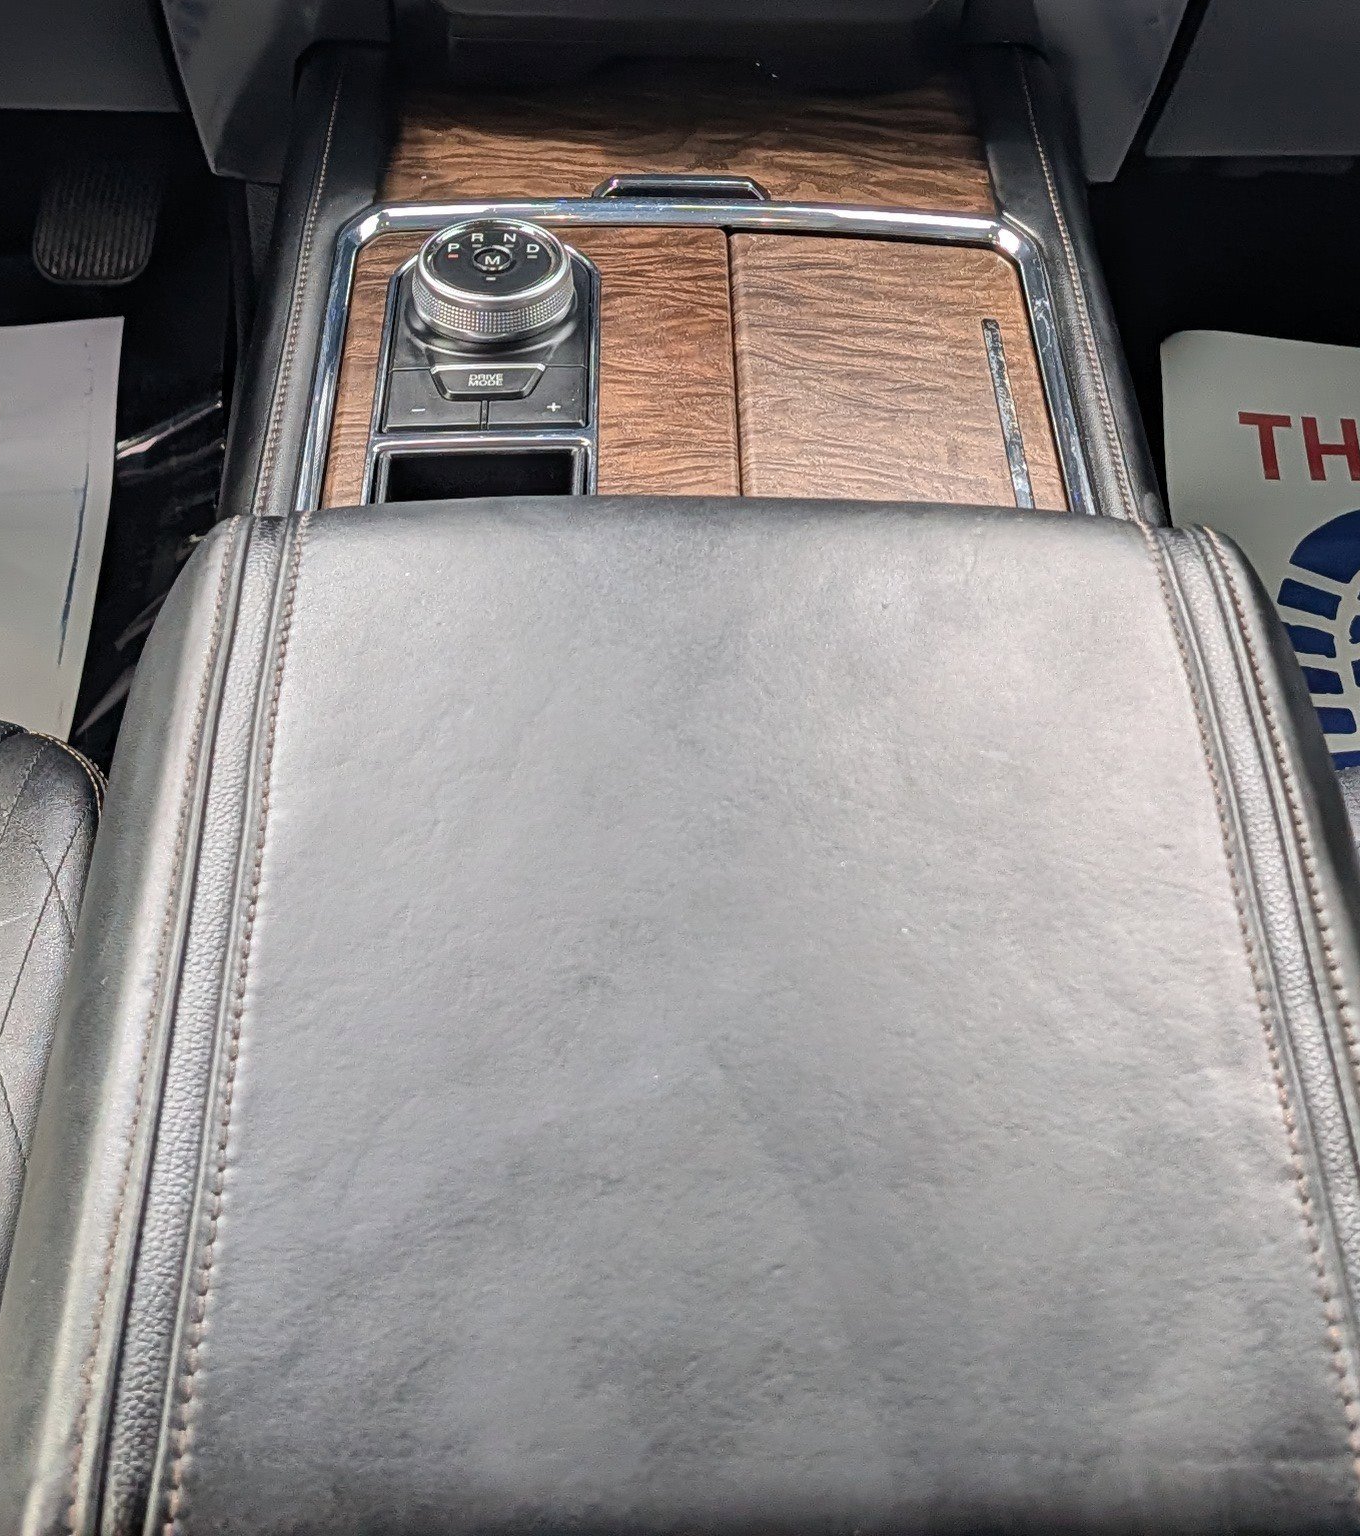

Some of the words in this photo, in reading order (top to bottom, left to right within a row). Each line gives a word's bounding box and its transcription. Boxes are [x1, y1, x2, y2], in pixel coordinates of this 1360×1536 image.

[446, 242, 460, 253] P
[471, 232, 484, 242] R
[503, 232, 517, 243] N
[526, 243, 539, 254] D
[484, 255, 501, 265] M
[468, 372, 503, 380] DRIVE
[468, 379, 503, 387] MODE
